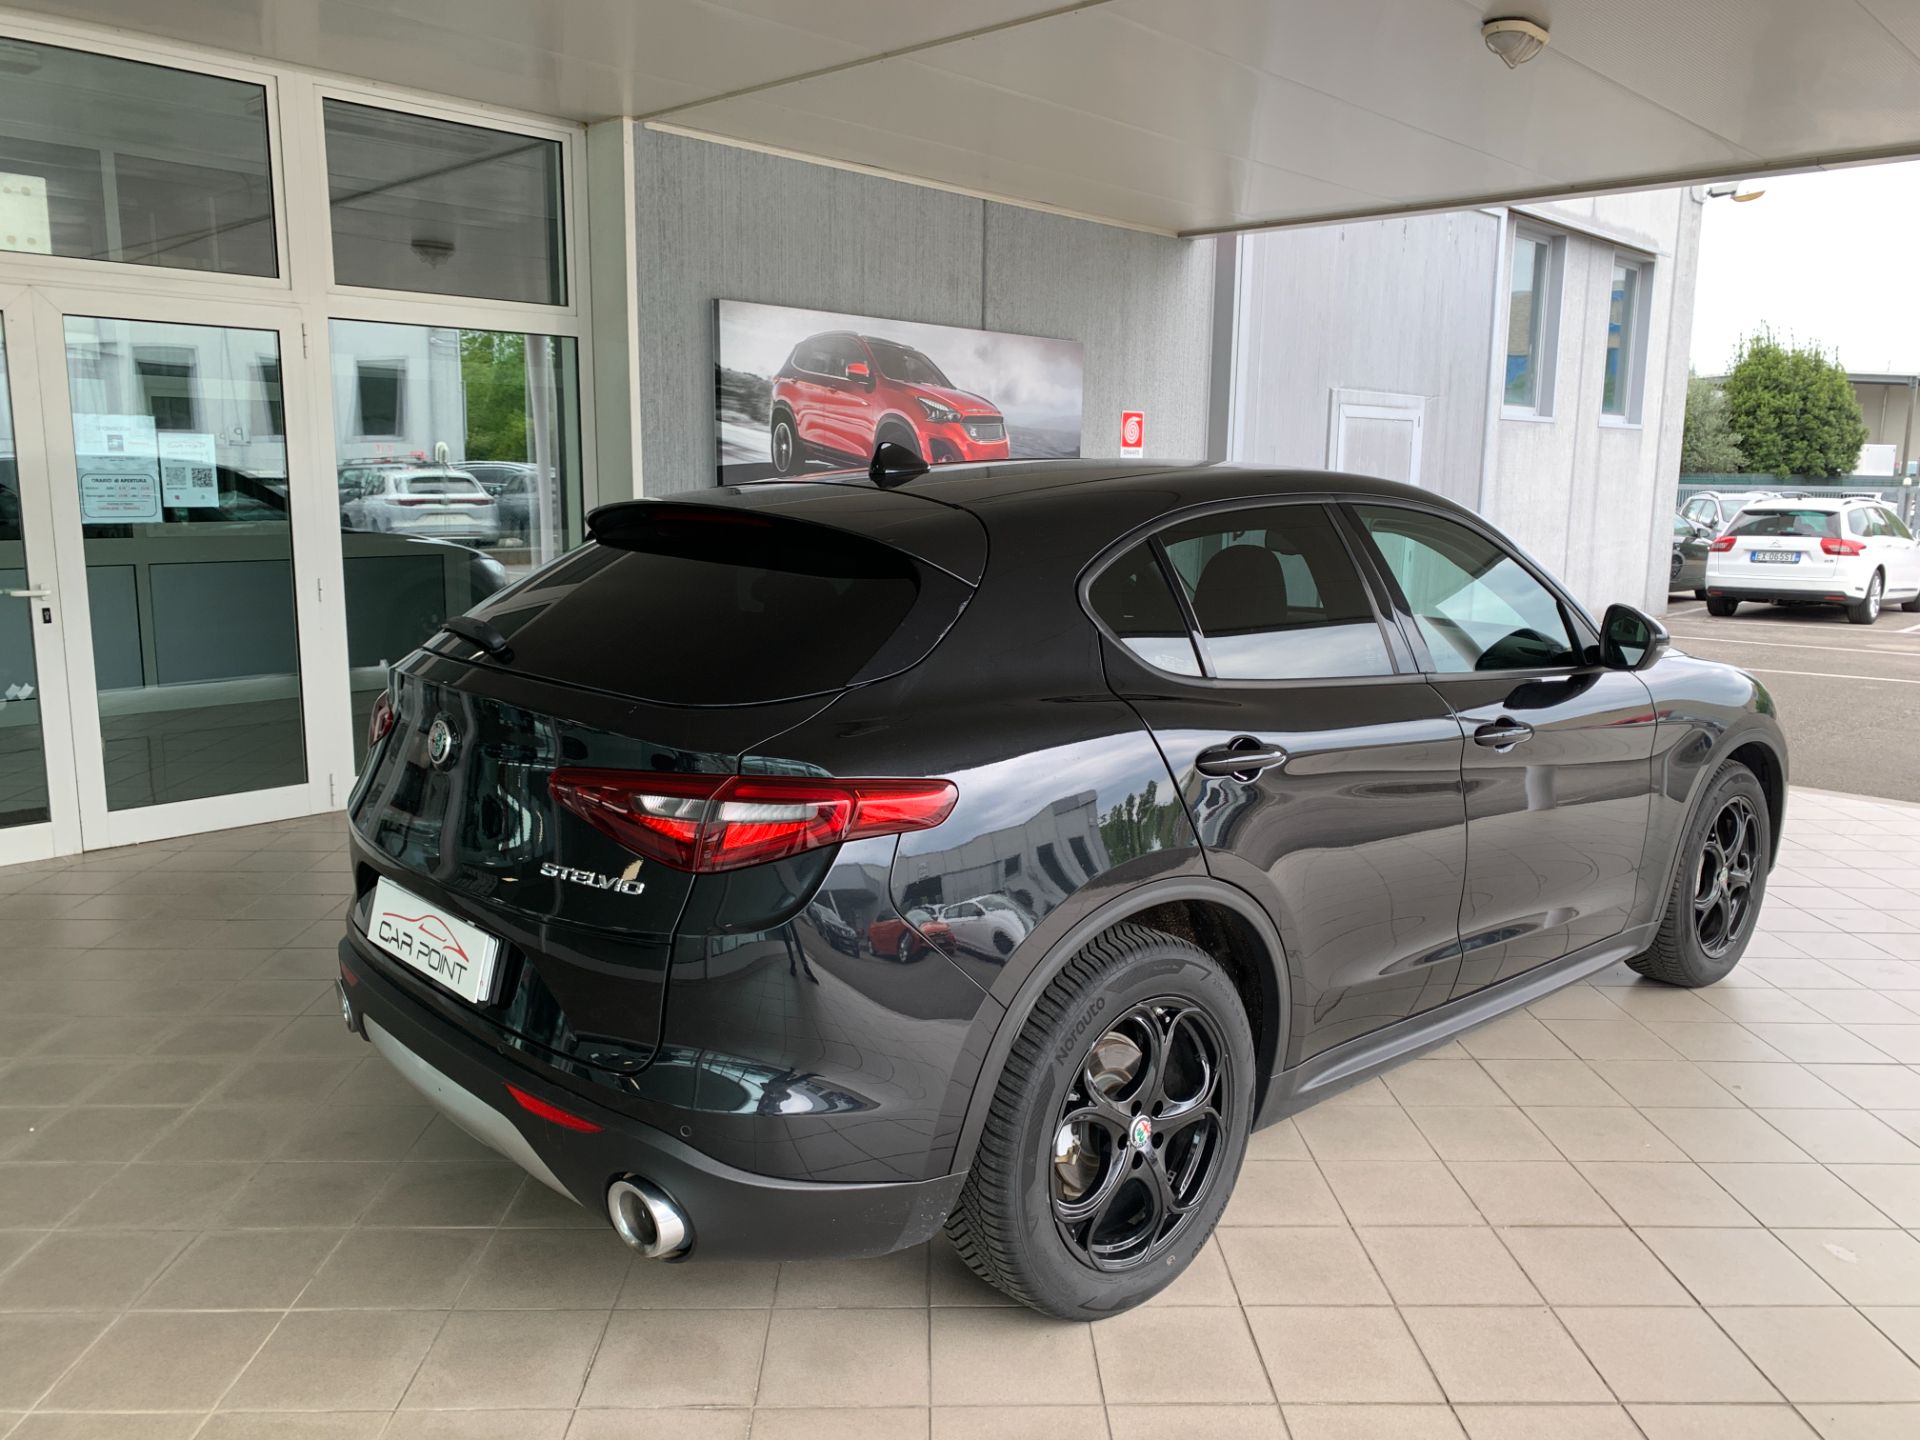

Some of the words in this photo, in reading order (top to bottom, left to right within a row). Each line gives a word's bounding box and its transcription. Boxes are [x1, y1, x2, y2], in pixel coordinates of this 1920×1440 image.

[540, 862, 645, 895] STELVIO
[379, 920, 413, 956] CAR
[417, 941, 467, 985] POINT
[1055, 997, 1105, 1067] Norauto
